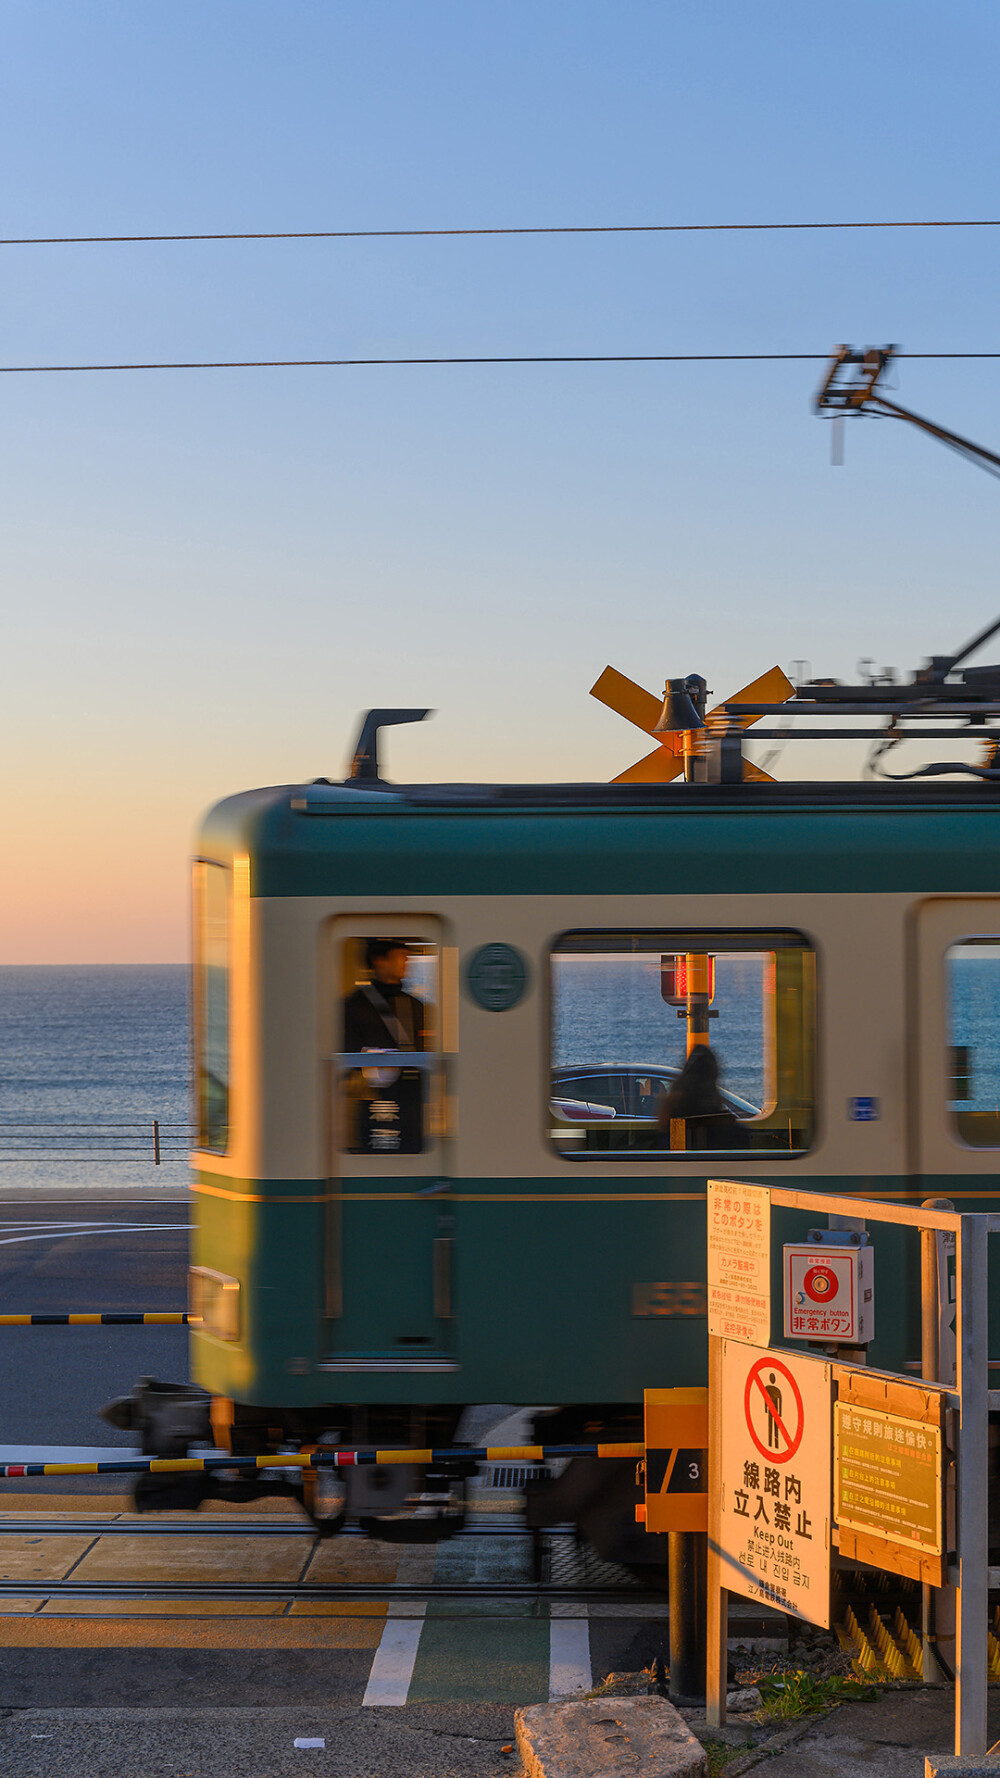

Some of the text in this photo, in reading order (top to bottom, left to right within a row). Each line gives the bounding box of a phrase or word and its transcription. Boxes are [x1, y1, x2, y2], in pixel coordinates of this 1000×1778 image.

[714, 1198, 760, 1216] 非常の際は
[714, 1212, 762, 1232] このボタンを
[720, 1257, 755, 1272] カメラ監視中
[794, 1307, 826, 1317] Emergency
[794, 1316, 850, 1332] 非常ボタン
[688, 1462, 700, 1479] 3
[743, 1460, 802, 1505] 線路内
[734, 1488, 812, 1540] 立入禁止
[754, 1526, 794, 1550] Keep Out
[738, 1552, 810, 1590] 선로 내 진입 금지
